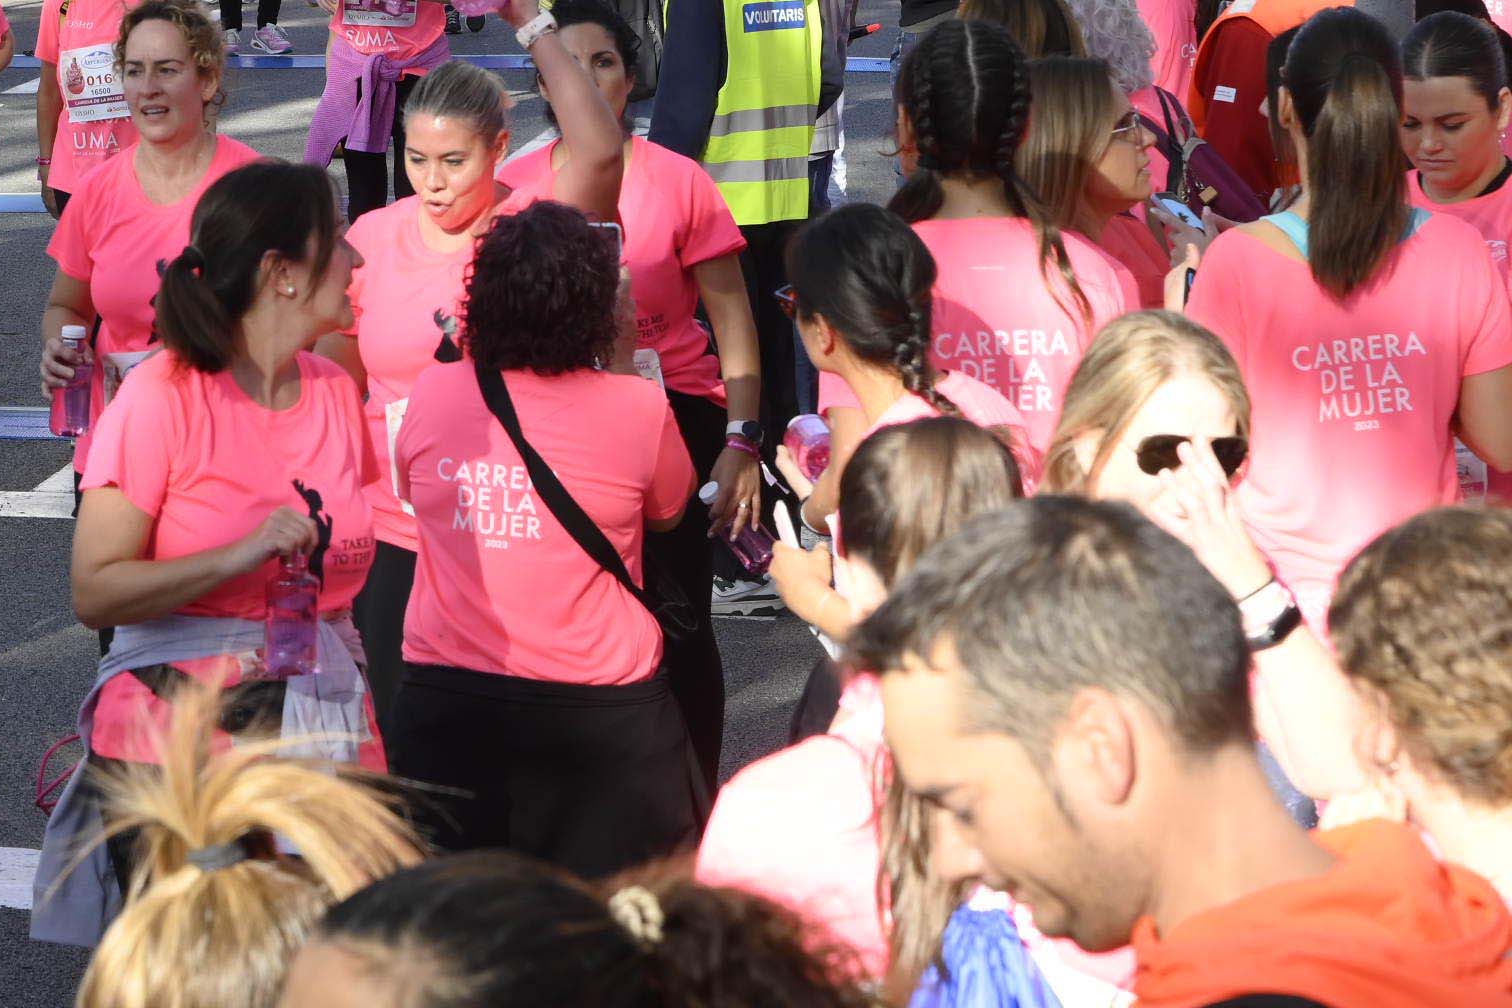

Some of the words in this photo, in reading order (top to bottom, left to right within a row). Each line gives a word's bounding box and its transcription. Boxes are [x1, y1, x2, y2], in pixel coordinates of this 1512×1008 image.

[346, 29, 397, 47] SUMA
[86, 74, 113, 86] 016
[90, 87, 111, 96] 16500
[73, 131, 119, 150] UMA
[934, 328, 1069, 360] CARRERA
[1291, 331, 1427, 371] CARRERA
[960, 358, 997, 385] DE
[1008, 356, 1047, 384] LA
[1320, 365, 1356, 394] DE
[1365, 360, 1404, 388] LA
[1319, 386, 1414, 423] MUJER
[437, 456, 533, 490] CARRE
[457, 484, 491, 511] DE
[503, 488, 537, 515] LA
[452, 508, 541, 540] MUJER
[341, 537, 370, 551] TAKE
[331, 553, 349, 566] TO
